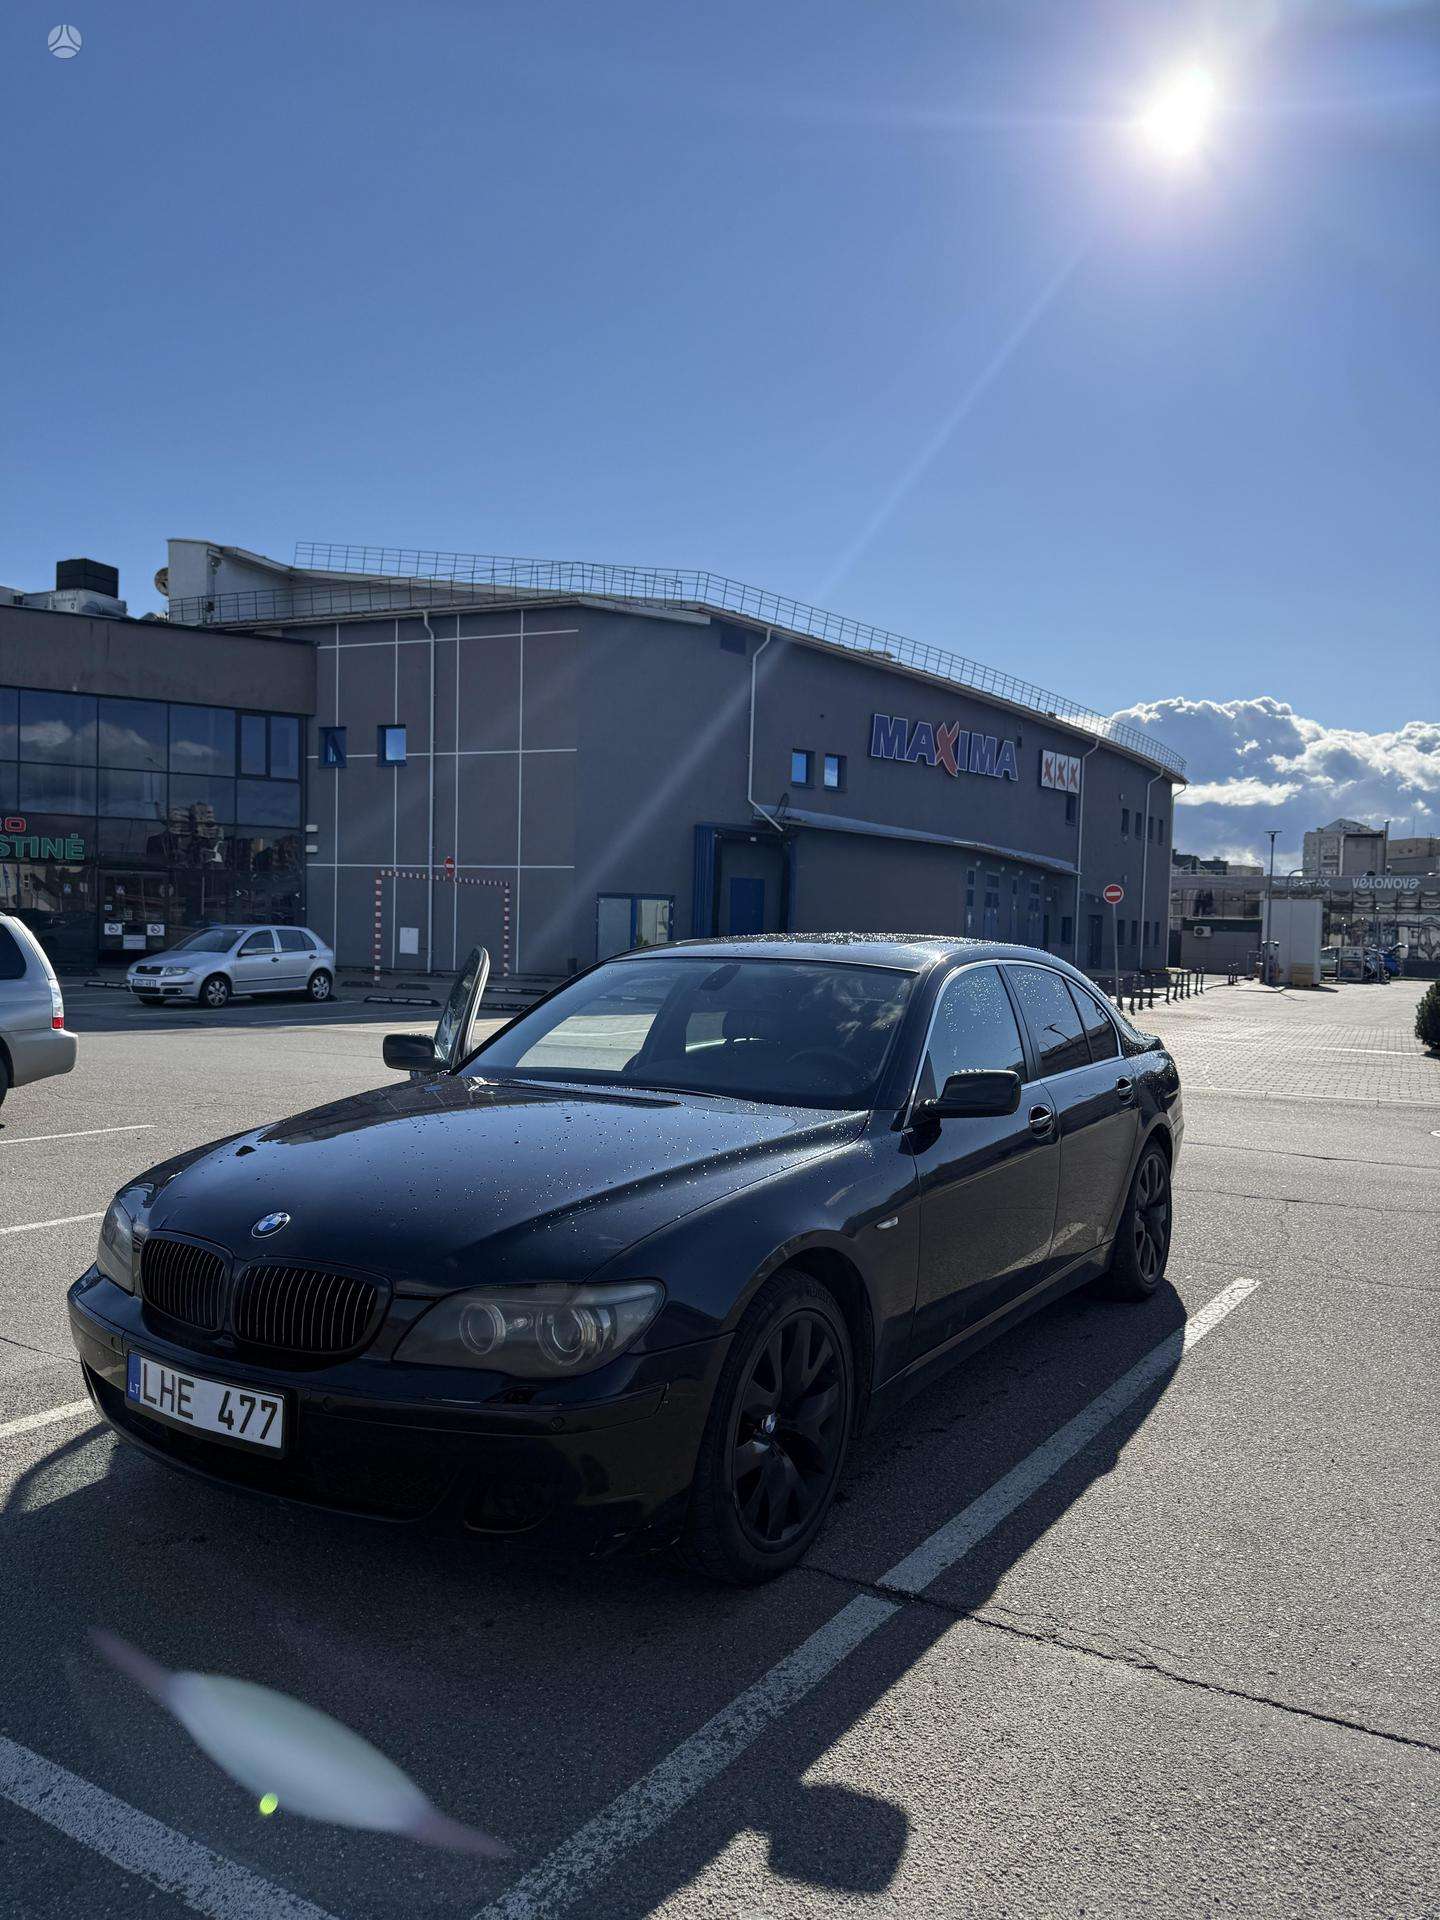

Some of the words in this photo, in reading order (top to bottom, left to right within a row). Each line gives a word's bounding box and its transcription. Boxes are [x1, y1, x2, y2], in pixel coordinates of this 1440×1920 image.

[870, 713, 1019, 782] MAXIMA
[129, 1381, 140, 1394] LT
[143, 1362, 195, 1420] LHE
[217, 1390, 278, 1440] 477
